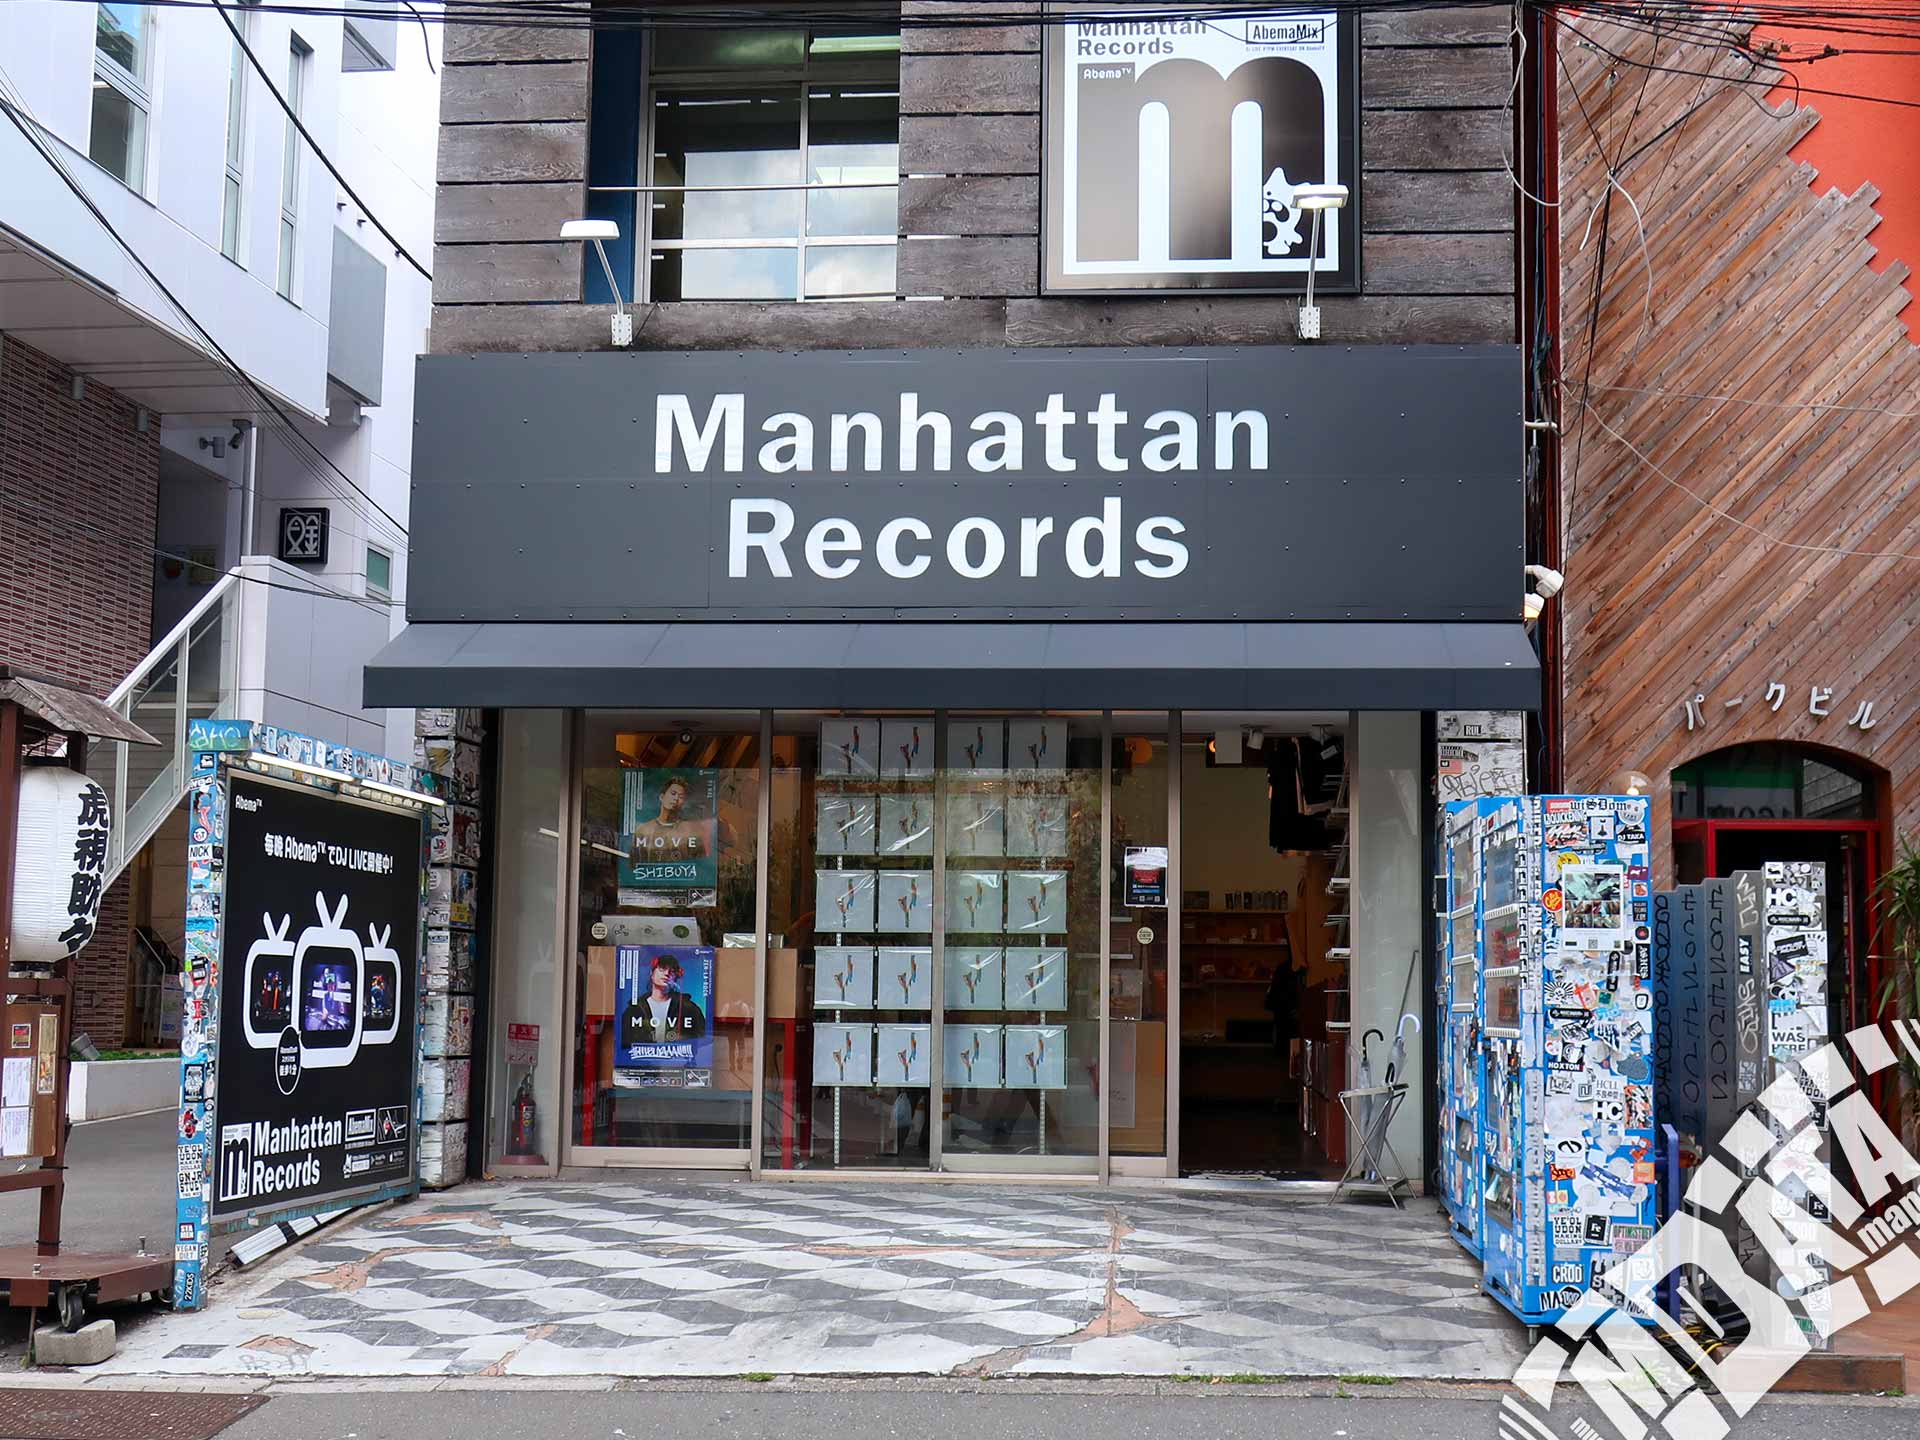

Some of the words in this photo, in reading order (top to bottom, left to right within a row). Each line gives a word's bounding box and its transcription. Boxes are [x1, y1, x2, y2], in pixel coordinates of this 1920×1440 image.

[1253, 24, 1318, 40] AbemaMix
[1077, 37, 1174, 56] Records
[654, 391, 1271, 474] Manhattan
[728, 496, 1190, 580] Records
[1685, 682, 1876, 730] パークビル
[189, 845, 210, 858] NICK
[635, 837, 697, 848] MOVE
[632, 864, 697, 880] SHIBUYA
[1740, 937, 1750, 975] EASY
[631, 1016, 693, 1028] MOVE
[1771, 1031, 1806, 1043] WAS
[1547, 1062, 1581, 1072] HOXTON
[1592, 1101, 1623, 1121] HC
[253, 1115, 342, 1157] Manhattan
[252, 1152, 321, 1196] Records
[1552, 1264, 1583, 1284] CRUD
